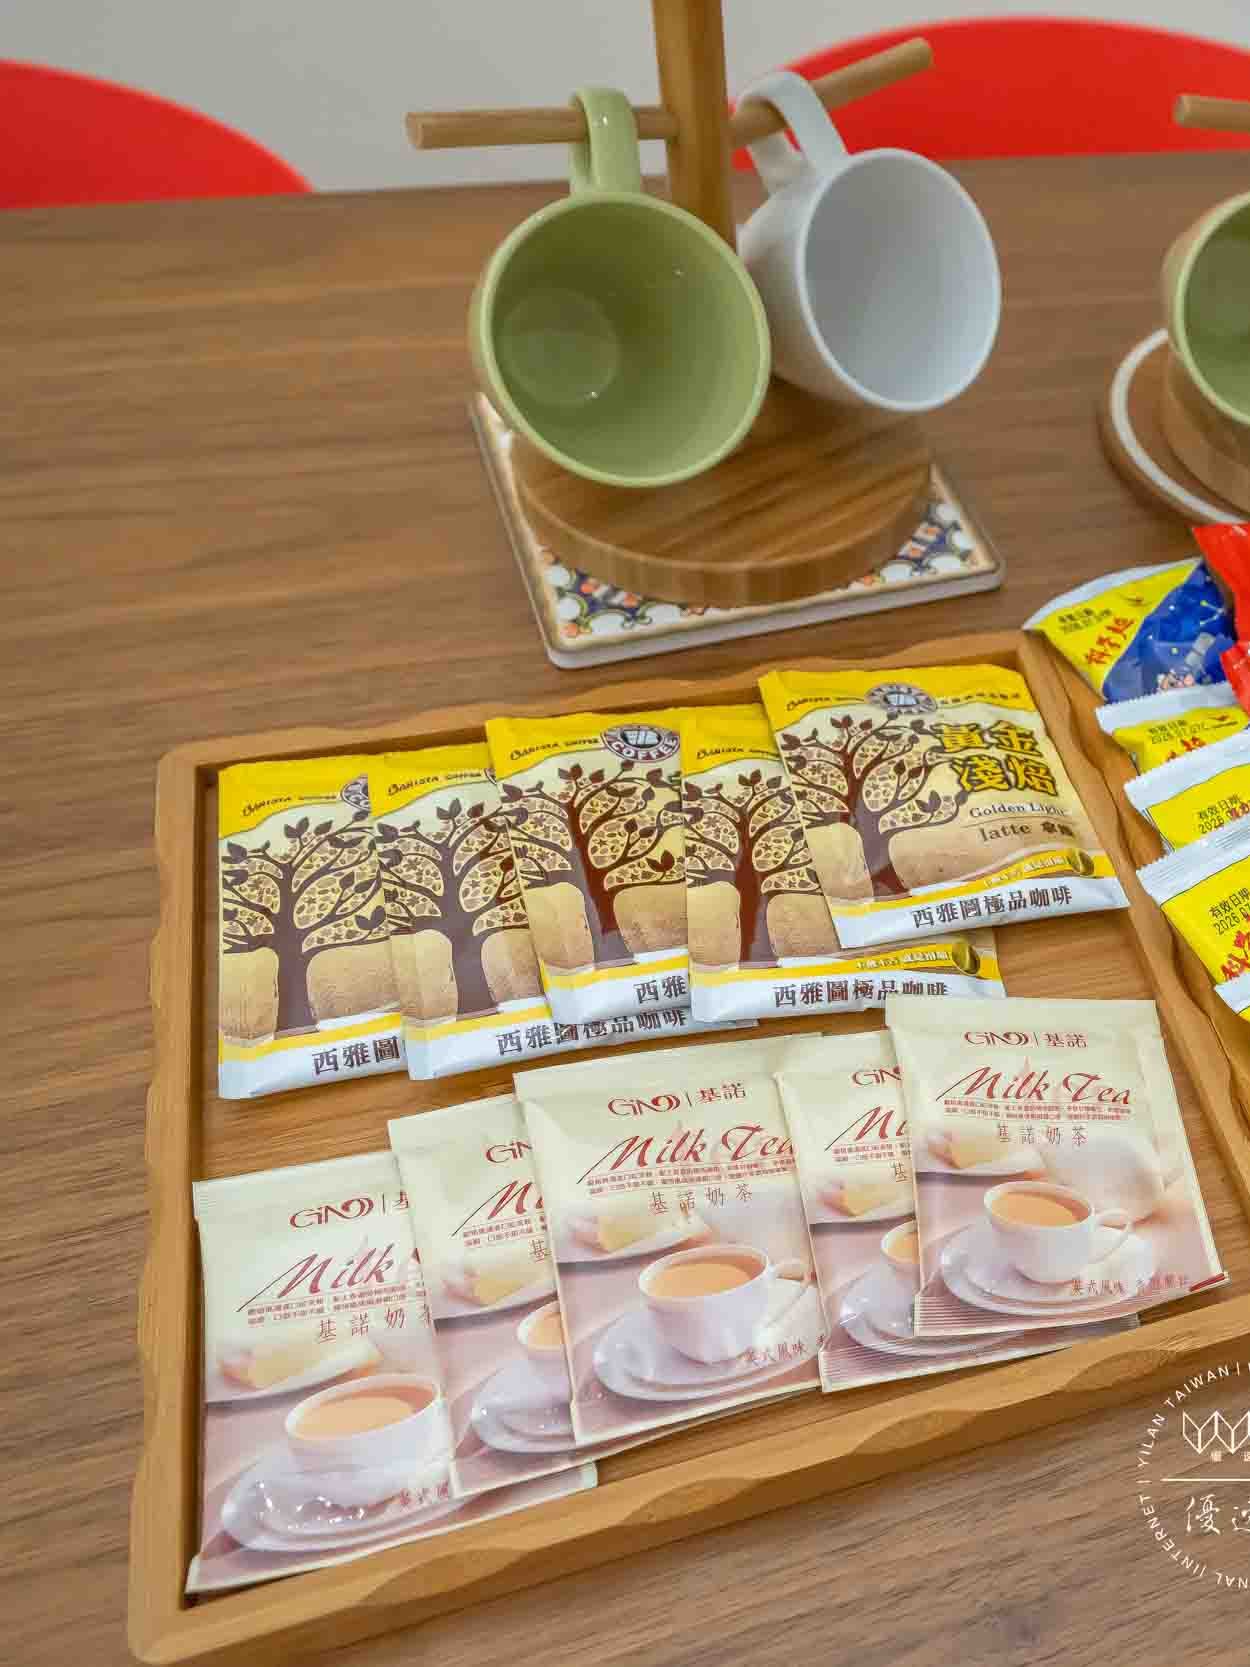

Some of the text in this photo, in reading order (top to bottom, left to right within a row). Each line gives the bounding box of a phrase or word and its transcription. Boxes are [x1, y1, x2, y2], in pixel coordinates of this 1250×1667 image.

[929, 719, 1044, 758] 黃金
[968, 804, 1026, 819] Golden
[978, 823, 1033, 843] latte
[912, 884, 1073, 929] 西雅圖極品咖啡
[632, 974, 687, 1004] 西雅
[772, 976, 949, 1009] 西雅圖極品咖啡
[311, 1035, 400, 1076] 西雅圖
[698, 1082, 747, 1105] 基諾
[935, 1066, 1132, 1105] Milk Tea
[996, 1120, 1089, 1147] 基諾奶茶
[575, 1127, 706, 1185] Milk
[721, 1124, 794, 1162] Tea
[649, 1183, 753, 1216] 基諾奶茶
[234, 1242, 396, 1314] Milk
